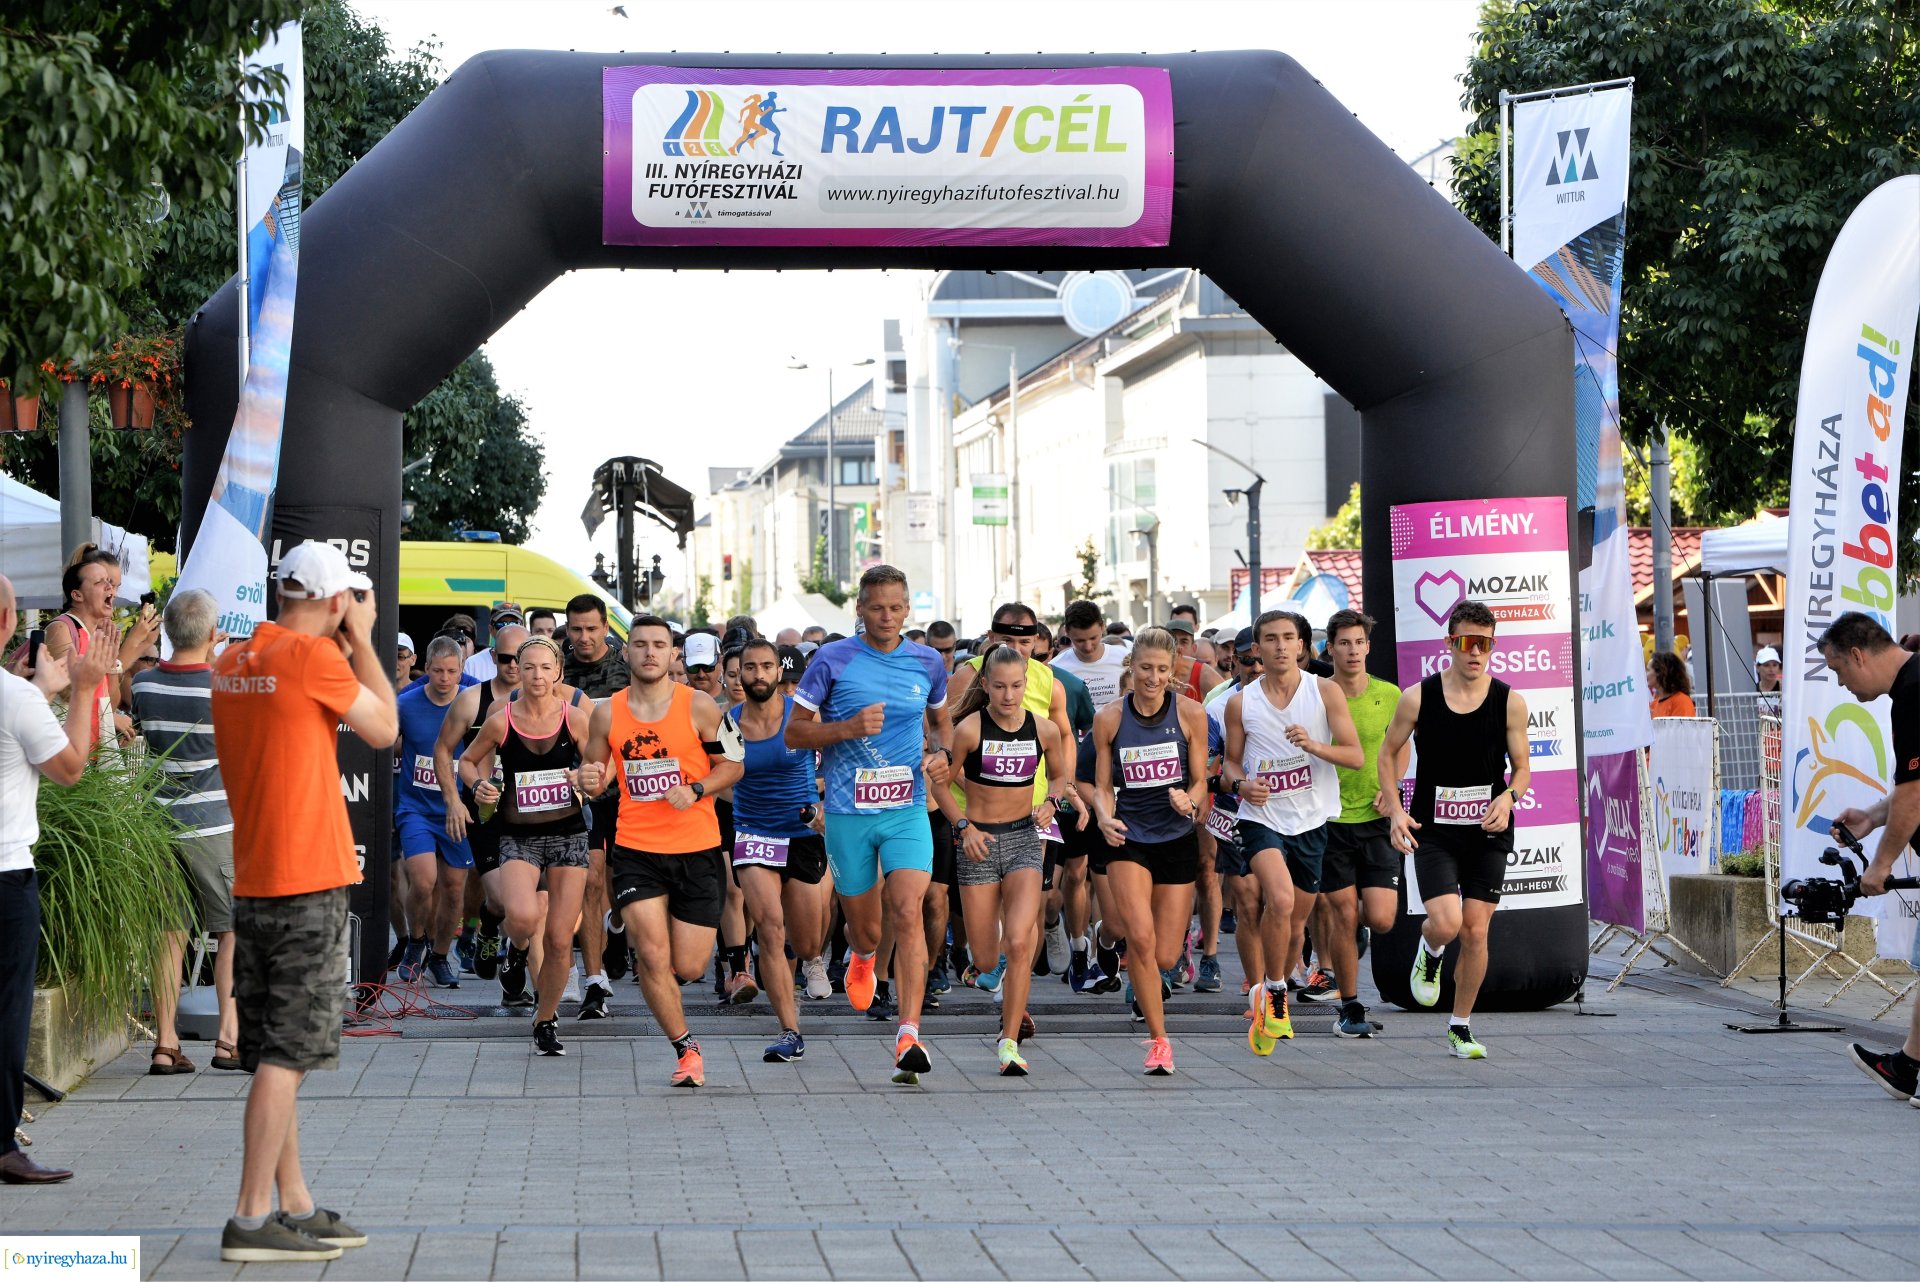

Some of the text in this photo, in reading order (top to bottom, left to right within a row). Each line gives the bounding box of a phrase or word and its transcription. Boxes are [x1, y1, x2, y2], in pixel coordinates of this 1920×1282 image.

[820, 94, 1127, 158] RAJT/CÉL
[645, 160, 803, 180] III. NYÍREGYHÁZI
[648, 180, 798, 200] FUTÓFESZTIVÁL
[827, 183, 1120, 205] www.nyiregyhazifutofesztival.hu
[1556, 190, 1586, 205] WITTUR
[717, 209, 772, 218] támogatásával
[1429, 508, 1539, 540] ÉLMÉNY.
[1841, 451, 1894, 632] bbet
[1467, 574, 1549, 595] MOZAIK
[1529, 592, 1550, 602] med
[1537, 728, 1557, 738] med
[995, 758, 1026, 774] 557
[1125, 760, 1178, 780] 10167
[628, 773, 681, 794] 10009
[1263, 768, 1311, 790] 0104
[519, 785, 570, 805] 10018
[857, 782, 912, 801] 10027
[1437, 802, 1489, 818] 10006
[1208, 811, 1233, 837] 1000
[745, 842, 775, 858] 545
[1506, 846, 1562, 867] OZAIK
[1544, 864, 1563, 873] med
